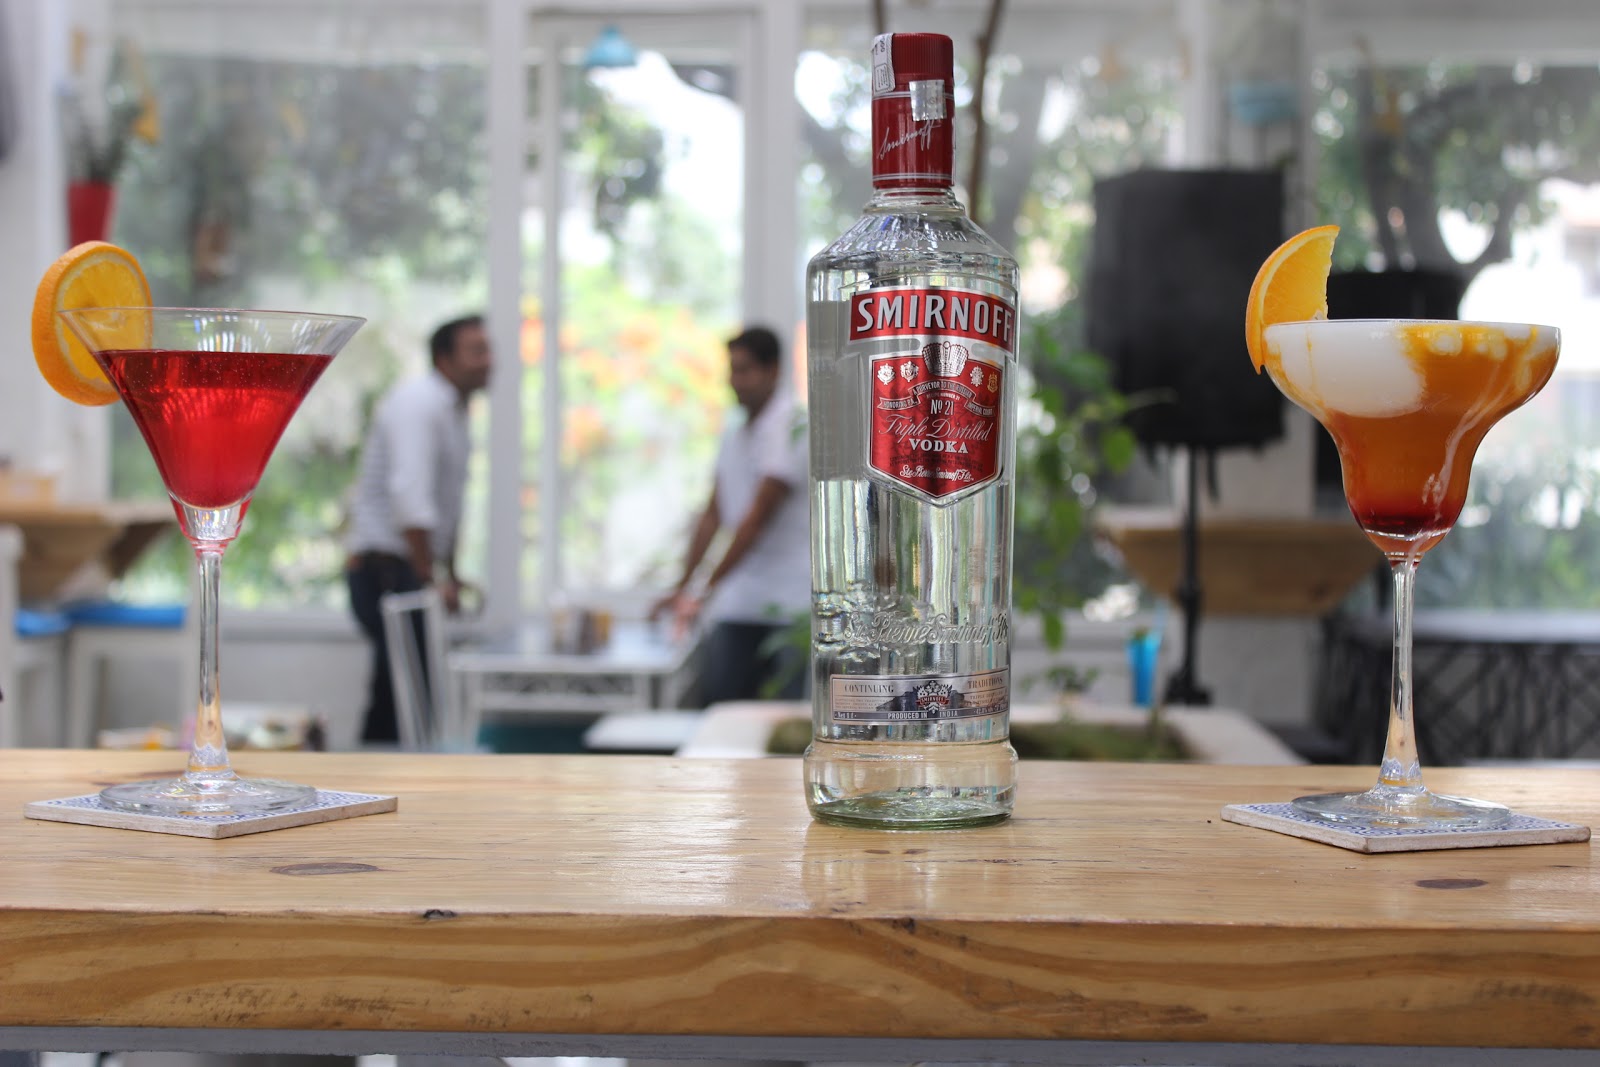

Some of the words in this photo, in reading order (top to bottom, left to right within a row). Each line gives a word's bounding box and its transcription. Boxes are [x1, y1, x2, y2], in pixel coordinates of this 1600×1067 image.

[857, 295, 1012, 342] SMIRNOFF
[916, 381, 940, 393] PURVEYOR
[944, 400, 954, 415] 21
[878, 414, 929, 443] Triple
[926, 418, 994, 441] Distilled
[909, 438, 968, 454] VODKA
[844, 684, 894, 693] CONTINUING
[968, 676, 1003, 689] TRADITIONS
[939, 710, 958, 718] INDIA
